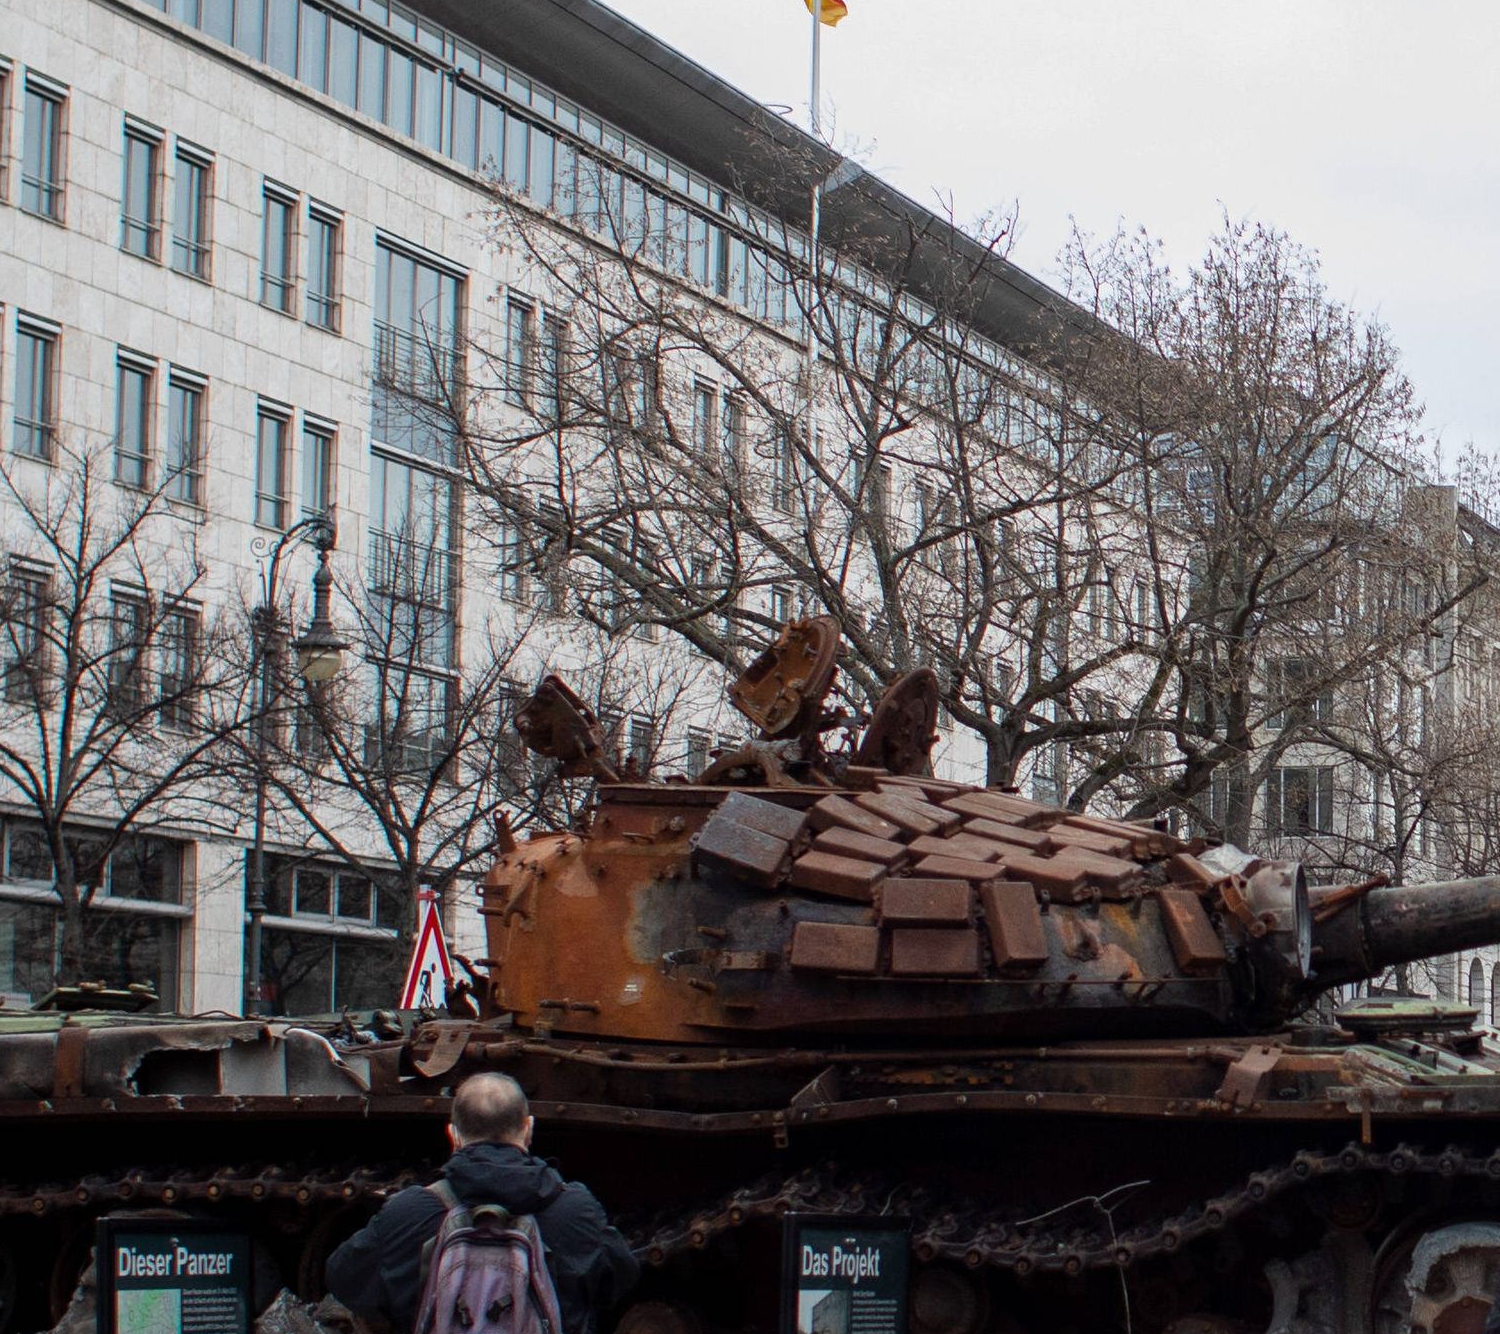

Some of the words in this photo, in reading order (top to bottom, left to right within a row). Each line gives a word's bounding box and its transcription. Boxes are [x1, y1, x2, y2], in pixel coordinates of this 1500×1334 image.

[118, 1247, 173, 1277] Dieser
[176, 1246, 233, 1276] Panzer
[802, 1245, 829, 1277] Das
[832, 1245, 880, 1284] Projekt
